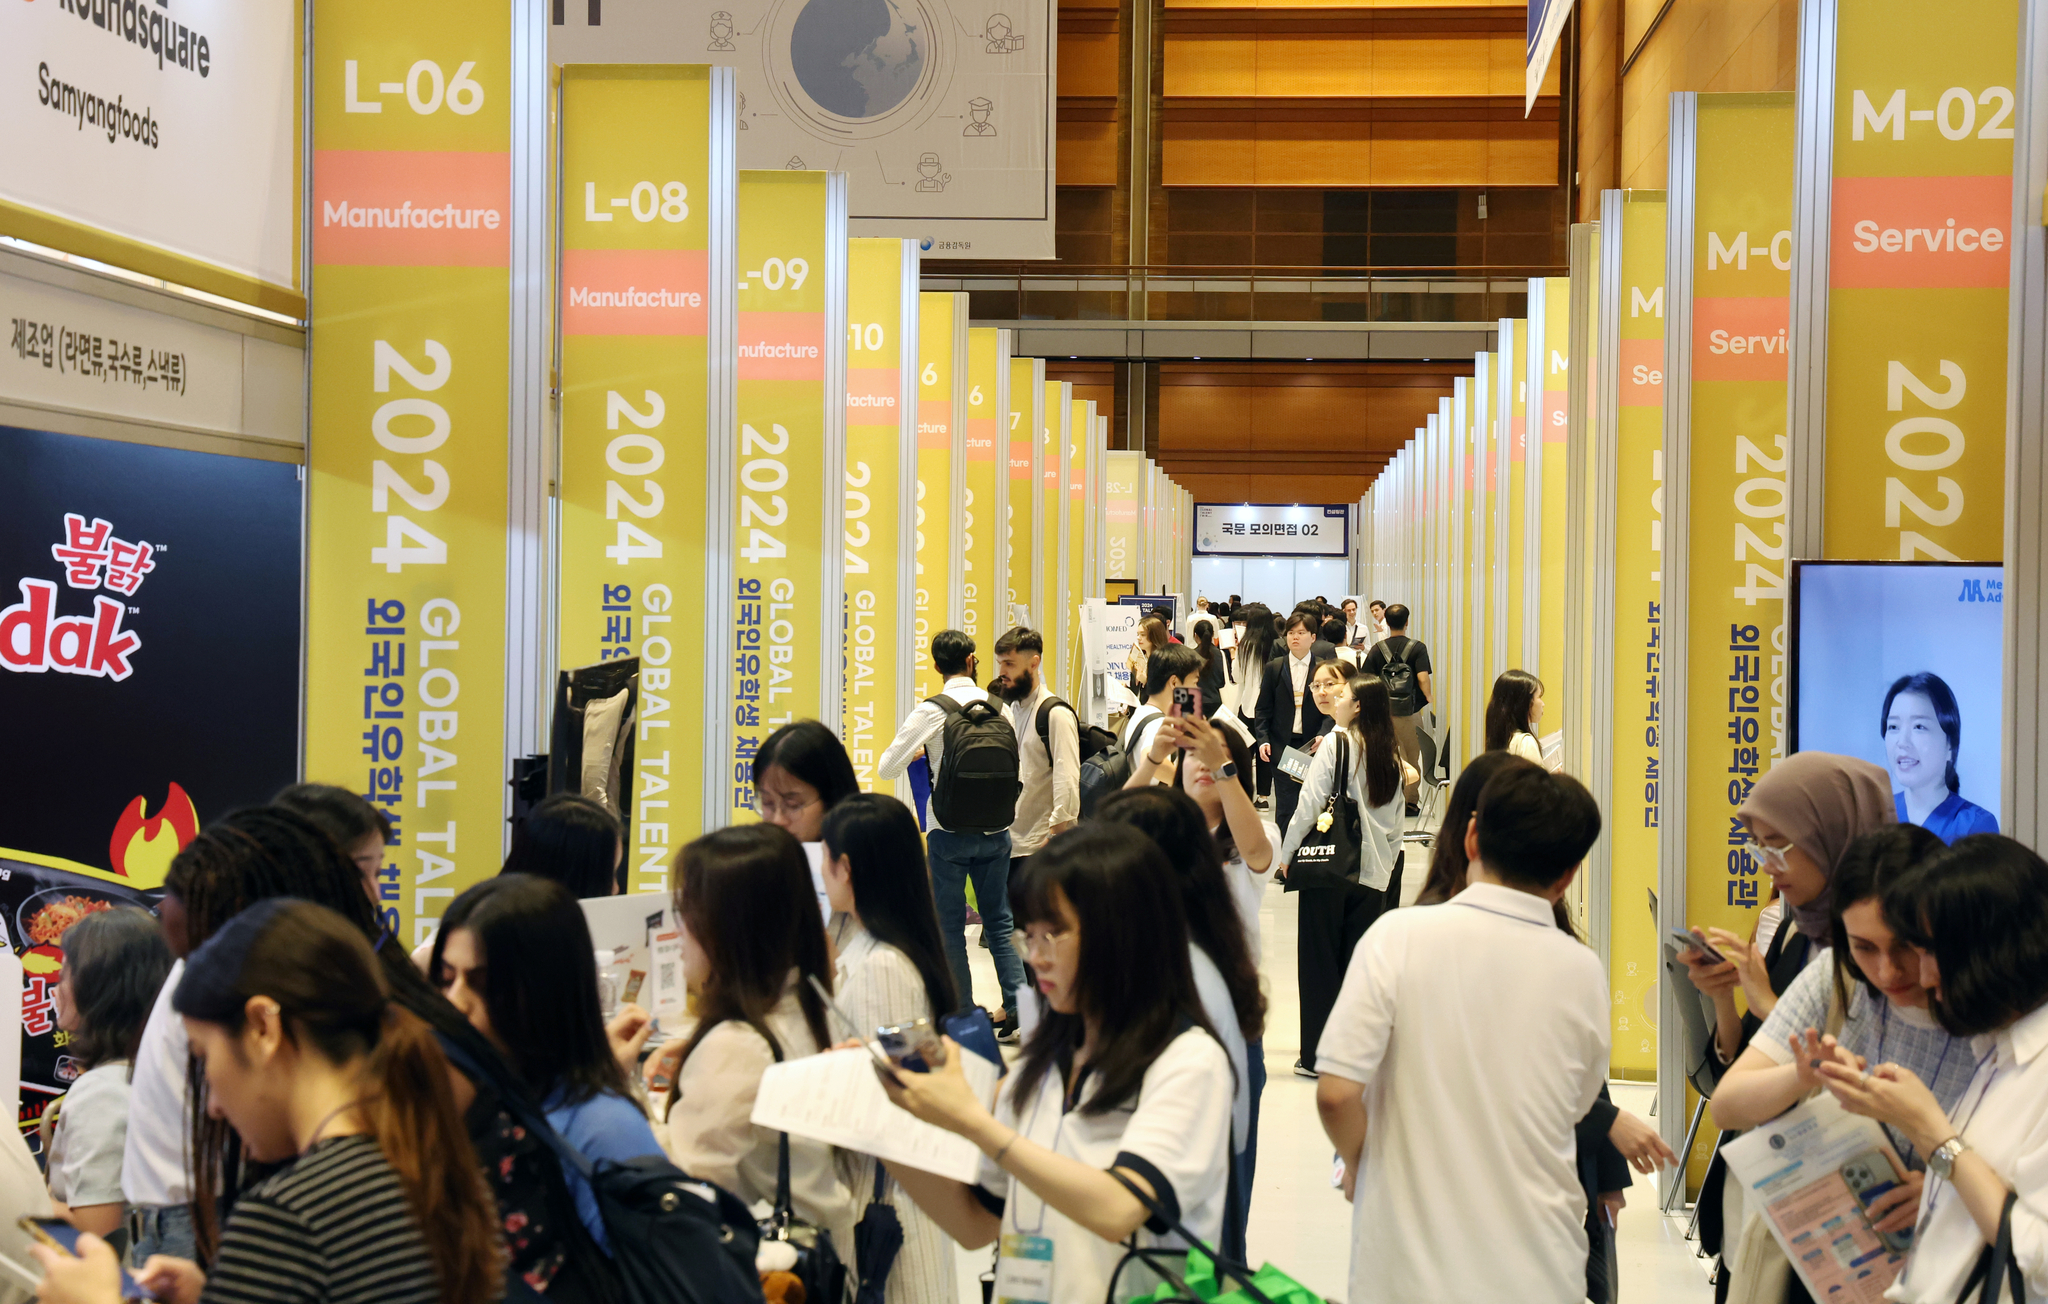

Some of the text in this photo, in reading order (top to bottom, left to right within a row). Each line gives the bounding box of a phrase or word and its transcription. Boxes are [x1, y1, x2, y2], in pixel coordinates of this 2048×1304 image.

[38, 61, 158, 149] Samyangfoods
[344, 59, 485, 116] L-06
[1852, 86, 2015, 141] M-02
[323, 200, 500, 230] Manufacture
[585, 181, 689, 223] L-08
[1707, 230, 1793, 271] M-0
[1853, 217, 2004, 253] Service
[569, 286, 701, 308] Manufacture
[738, 257, 809, 291] -09
[11, 318, 53, 368] 제조업
[738, 341, 818, 359] nufacture
[1709, 328, 1789, 355] Servi
[846, 393, 895, 408] facture
[371, 339, 452, 573] 2024
[605, 389, 665, 565] 2024
[740, 423, 789, 563] 2024
[1733, 434, 1787, 606] 2024
[52, 513, 155, 596] 불닭
[1222, 523, 1319, 536] 국문 모의면접 02
[0, 577, 142, 682] dak
[963, 583, 978, 636] GLOB
[735, 578, 761, 726] 외국인유학생
[768, 578, 795, 703] GLOBAL
[854, 589, 876, 695] GLOBAL
[639, 583, 672, 893] GLOBAL TALENT
[414, 598, 461, 945] GLOBAL TALE
